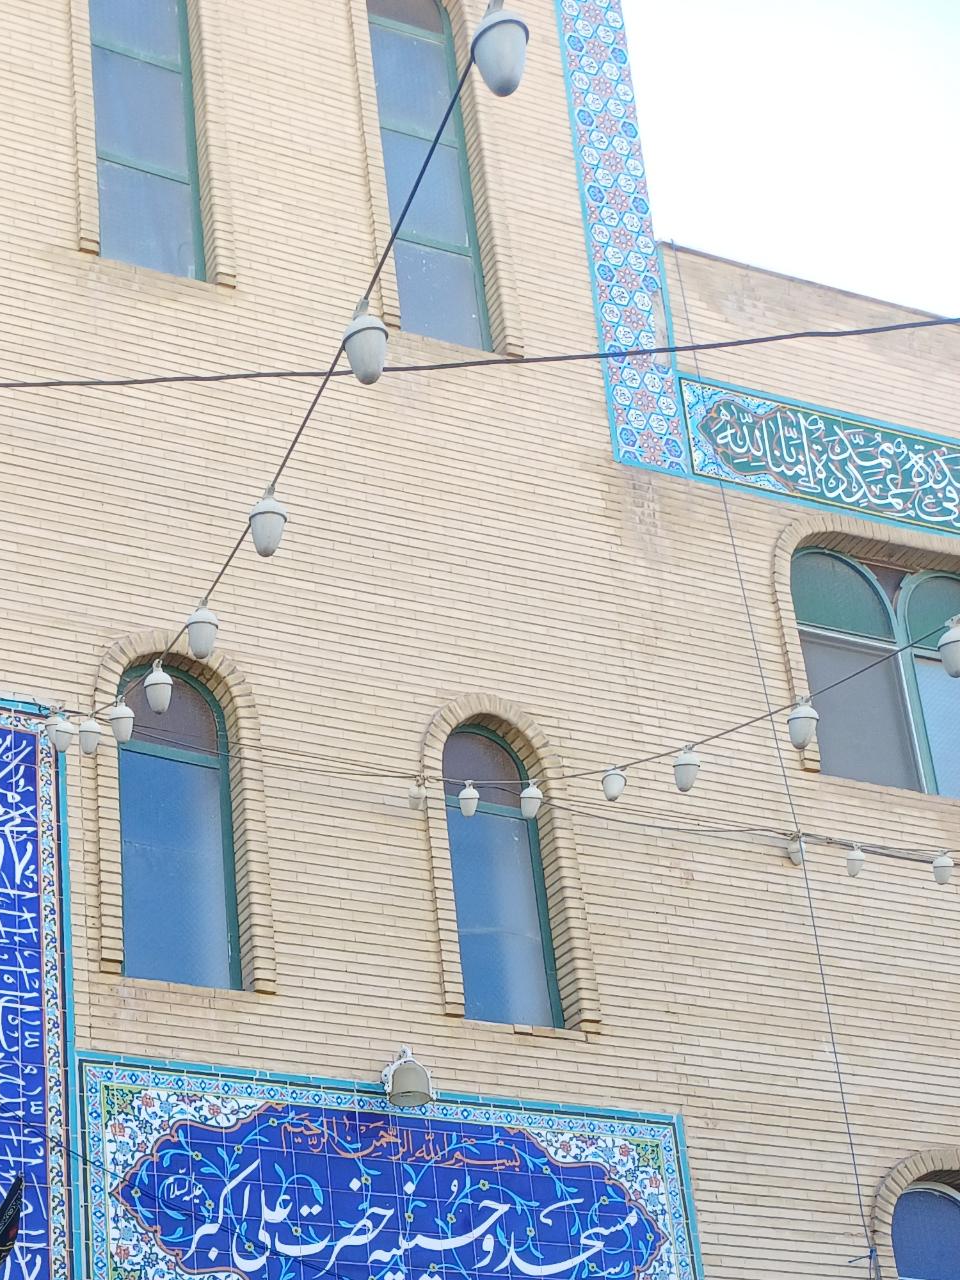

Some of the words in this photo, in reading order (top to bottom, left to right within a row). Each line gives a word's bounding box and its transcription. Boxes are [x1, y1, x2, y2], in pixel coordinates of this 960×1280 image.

[181, 1157, 258, 1262] اکبر
[231, 1188, 293, 1273] علی
[275, 1177, 395, 1280] حضرت
